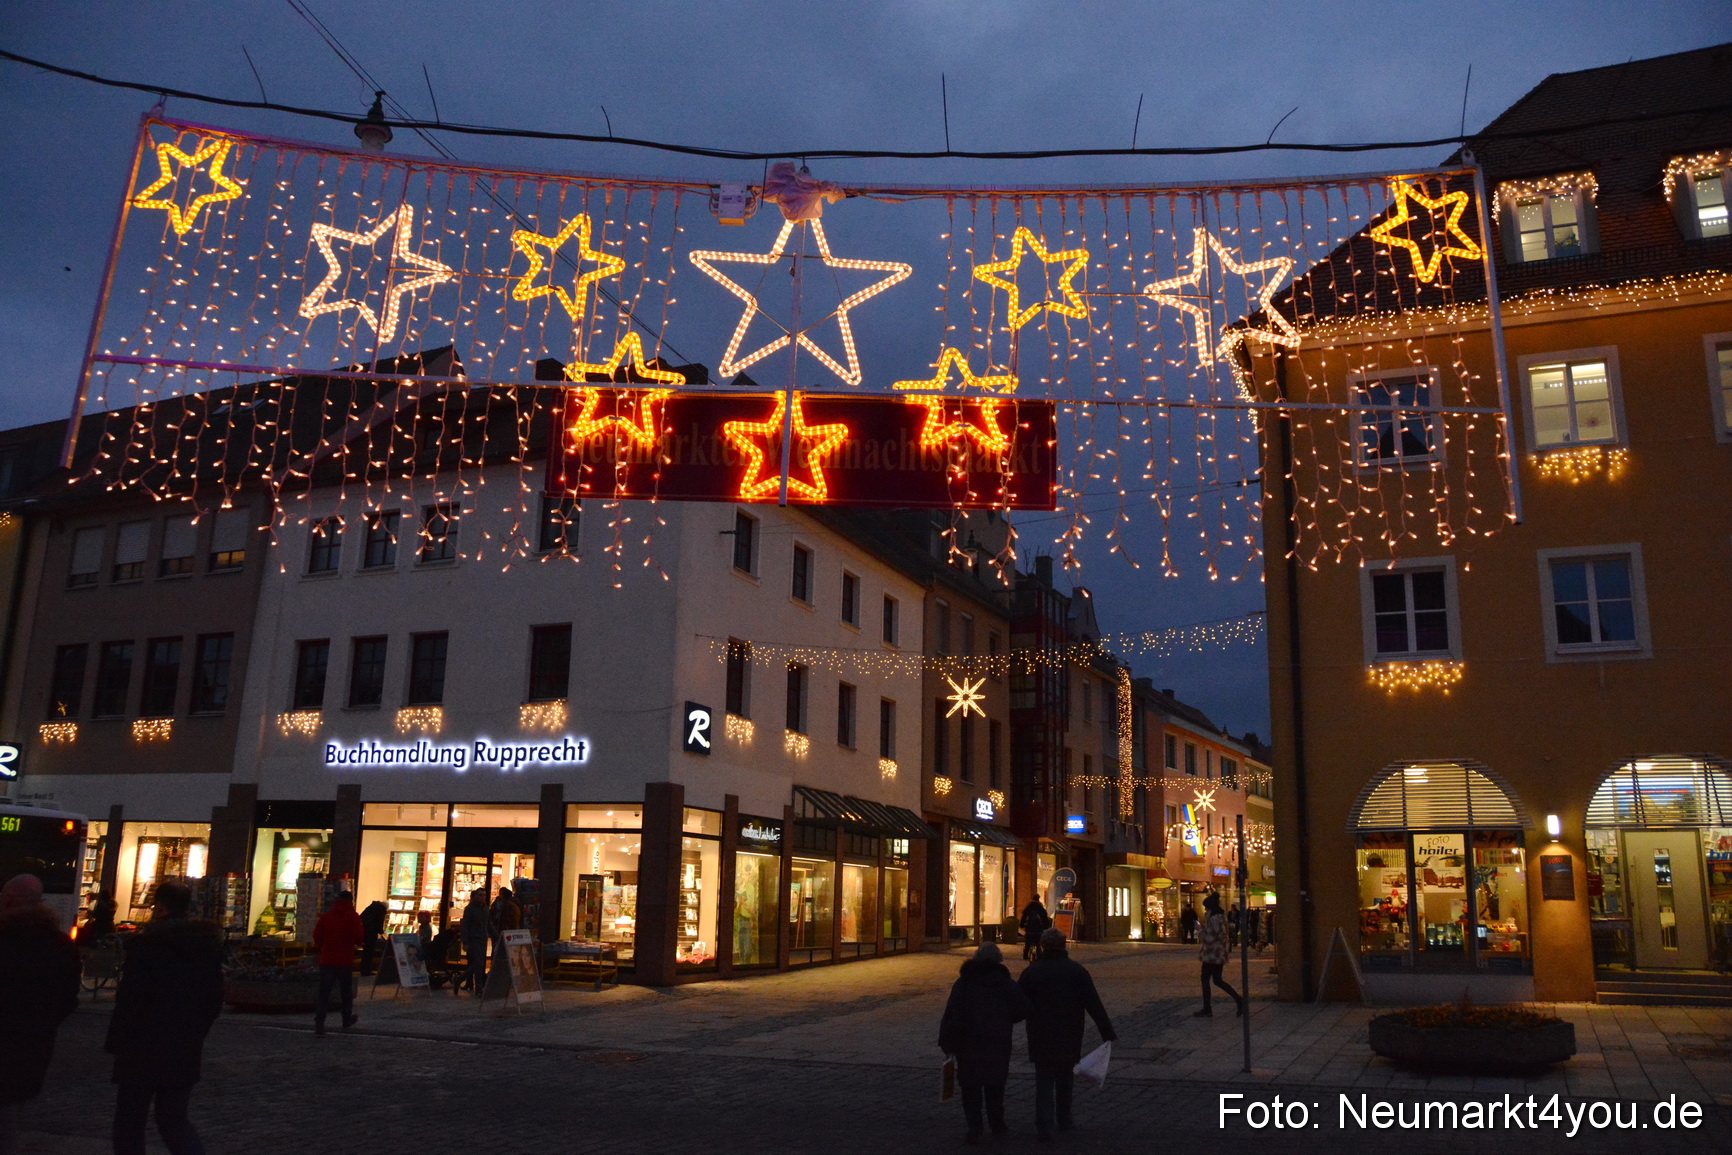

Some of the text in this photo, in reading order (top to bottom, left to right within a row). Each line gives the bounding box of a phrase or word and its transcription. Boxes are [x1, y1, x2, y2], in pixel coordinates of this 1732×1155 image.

[763, 424, 1042, 474] Wehnachtsmarkt
[325, 738, 587, 768] Buchhandlung Rupprecht
[1, 817, 20, 832] 561
[1426, 836, 1450, 848] FOTO
[1419, 846, 1459, 855] hailer
